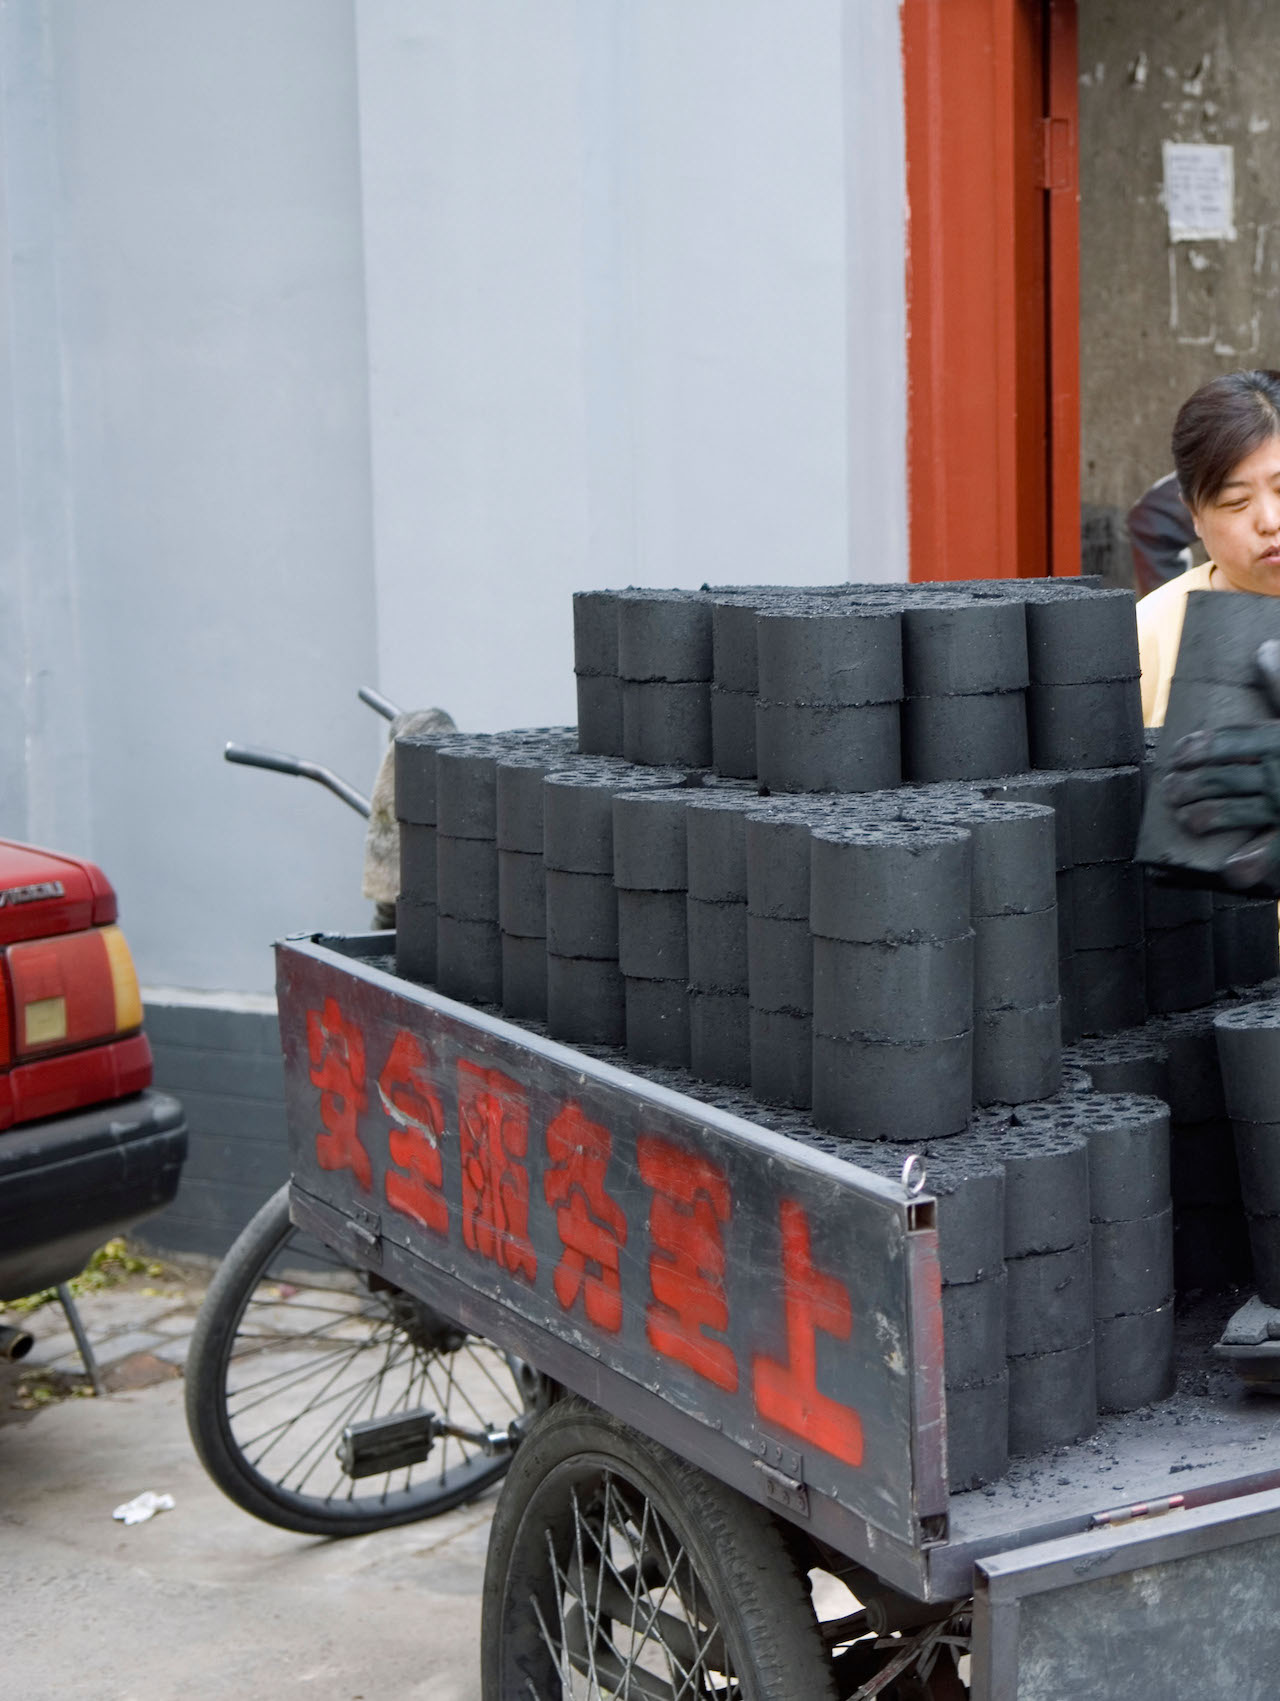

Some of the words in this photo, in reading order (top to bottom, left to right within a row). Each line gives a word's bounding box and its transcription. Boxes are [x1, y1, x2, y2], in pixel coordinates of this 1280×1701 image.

[306, 996, 865, 1468] 安全服务至上
